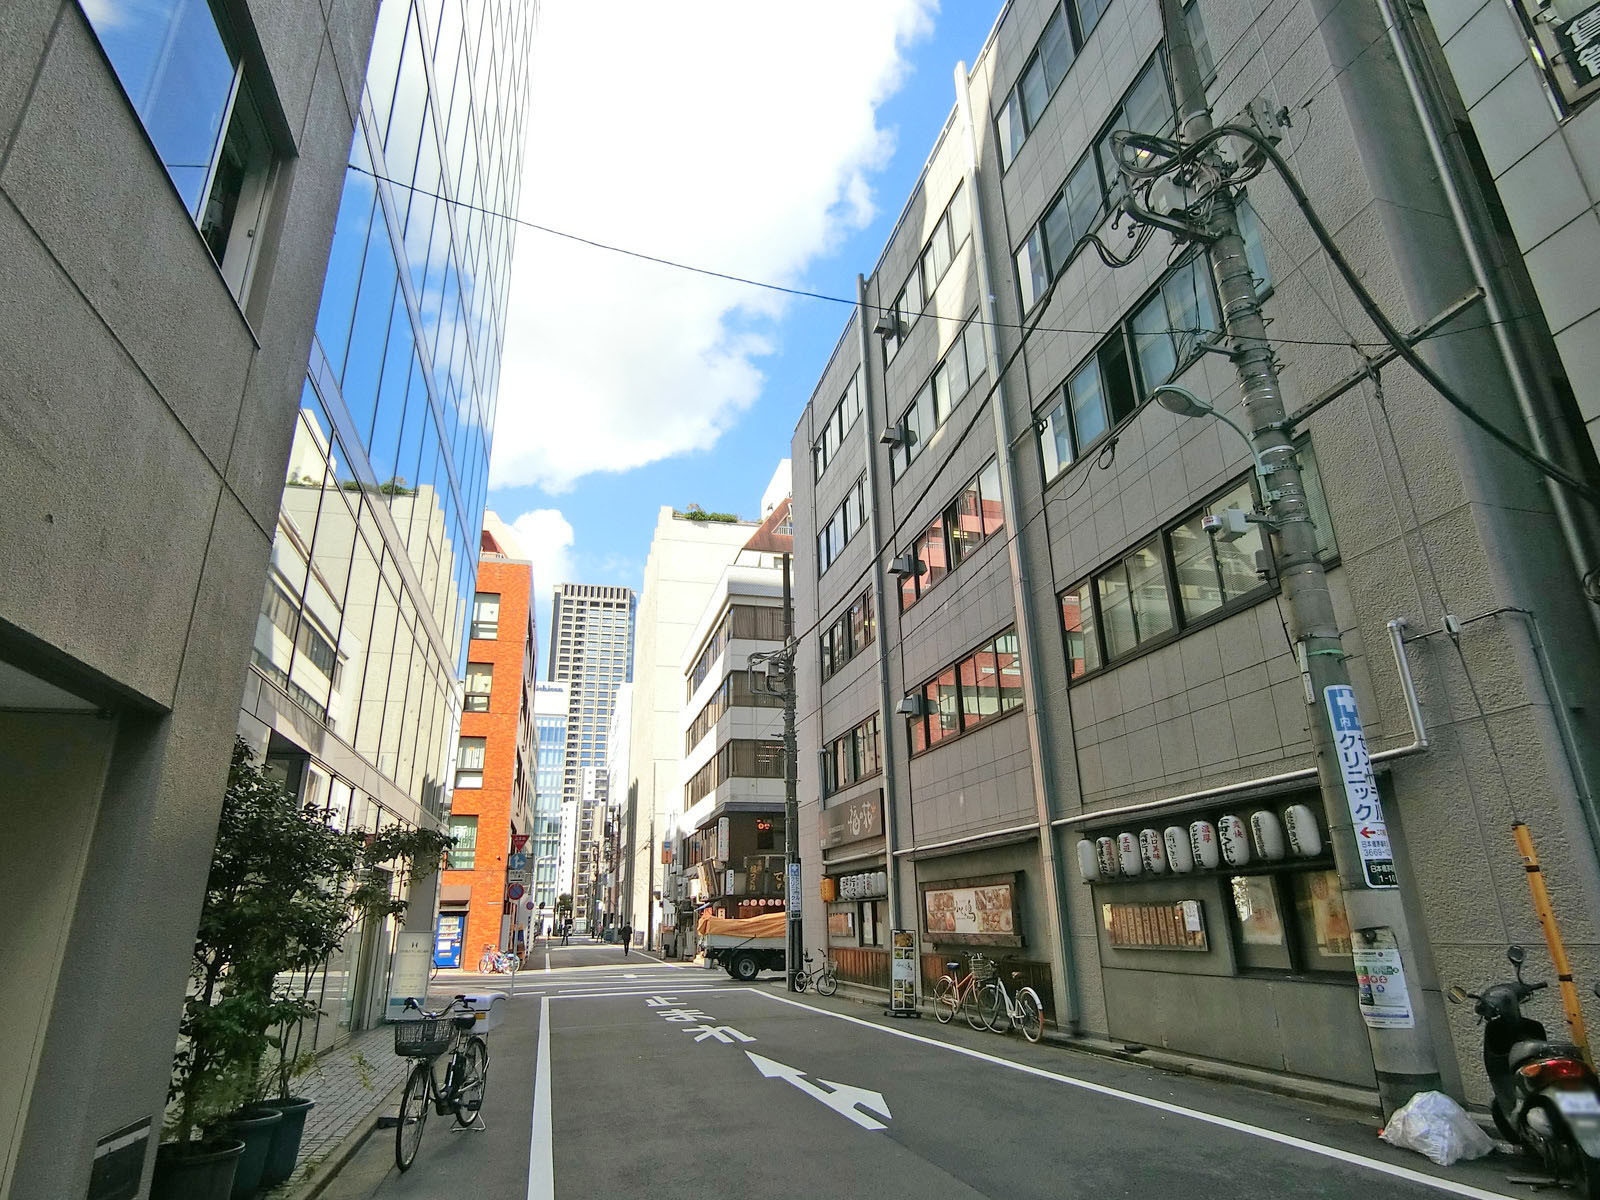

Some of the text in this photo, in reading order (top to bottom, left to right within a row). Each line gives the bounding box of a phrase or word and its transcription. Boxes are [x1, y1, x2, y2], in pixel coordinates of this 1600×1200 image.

[1339, 733, 1372, 822] クリニック
[646, 995, 757, 1043] 止まれ
